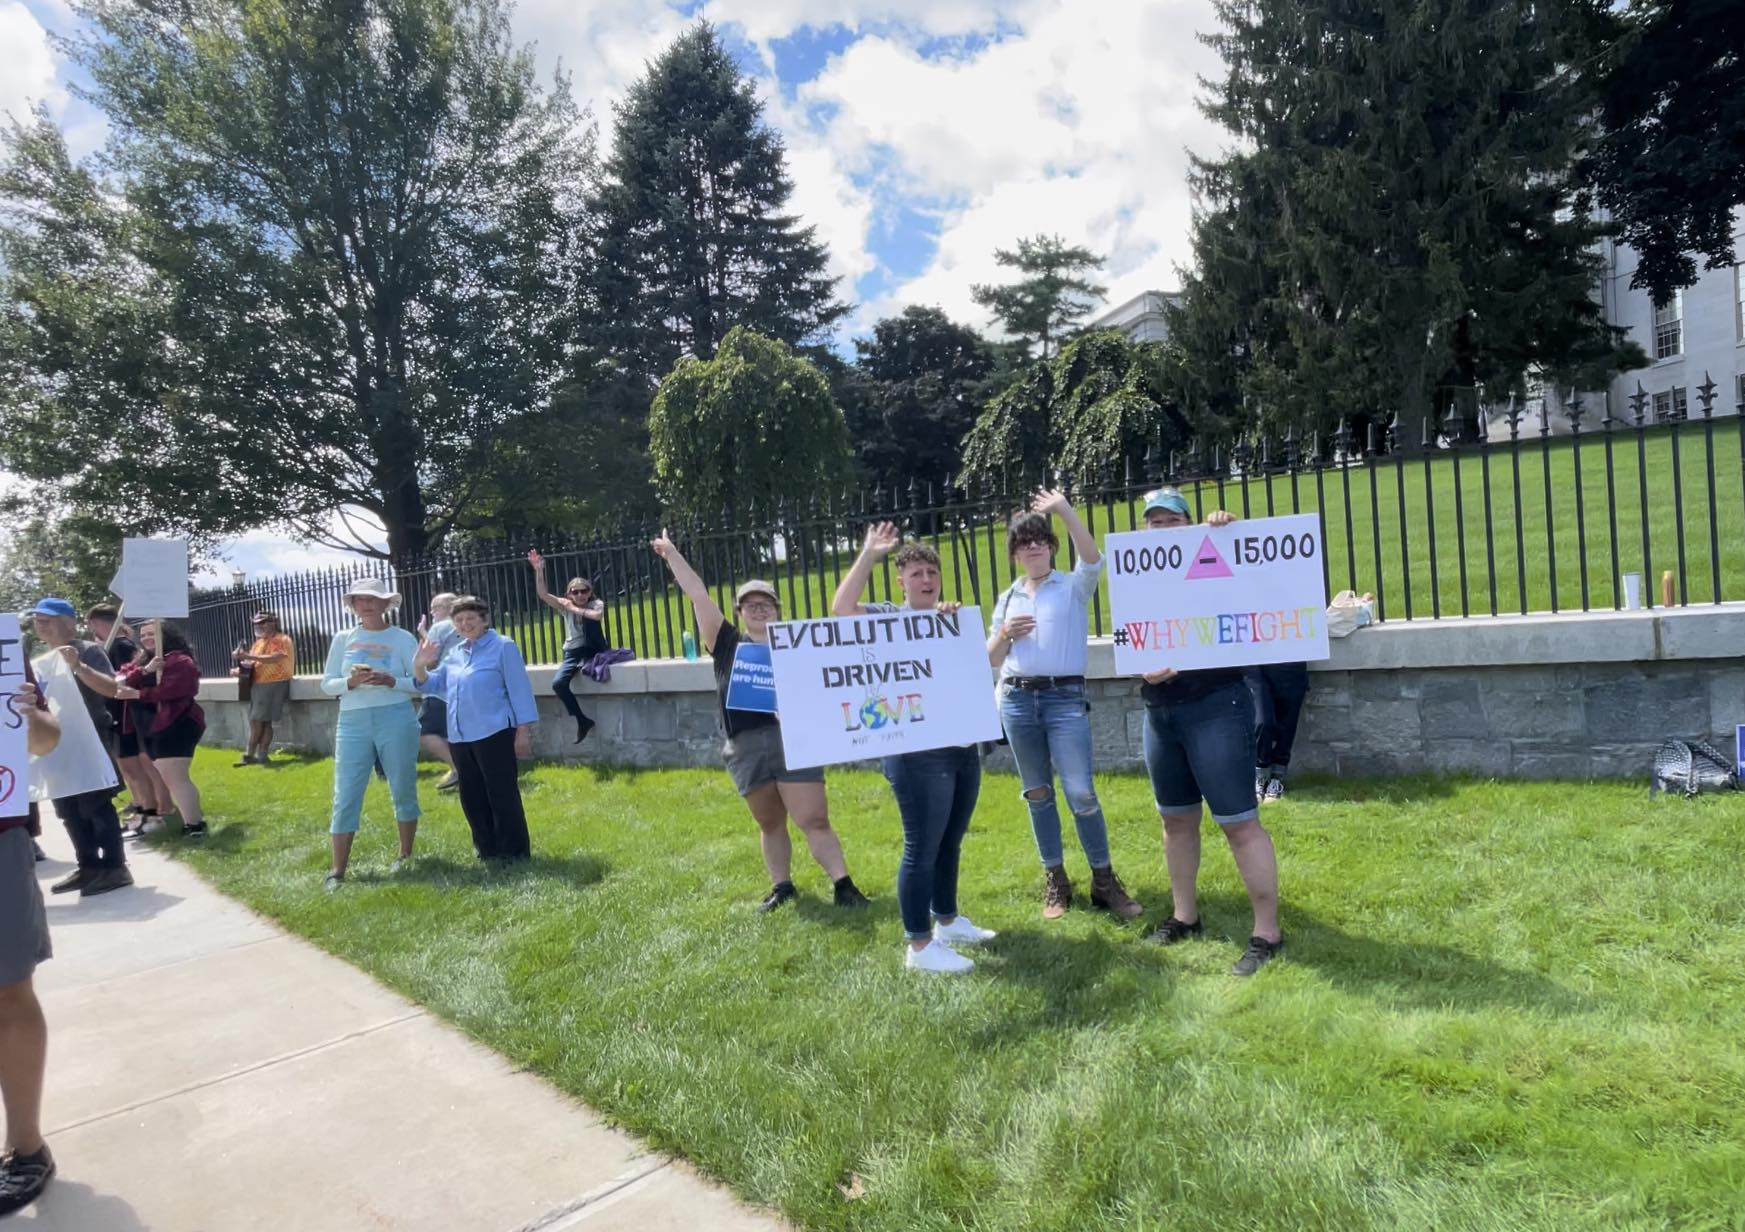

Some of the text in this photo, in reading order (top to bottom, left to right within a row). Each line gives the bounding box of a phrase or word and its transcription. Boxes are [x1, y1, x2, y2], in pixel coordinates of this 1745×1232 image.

[1114, 544, 1182, 576] 10,000
[1234, 532, 1315, 566] 15,000
[768, 612, 961, 650] EVOLUTION
[1113, 606, 1320, 651] #WHYWEFIGHT
[732, 672, 752, 684] are
[822, 658, 933, 689] DRIVEN
[0, 691, 22, 729] S
